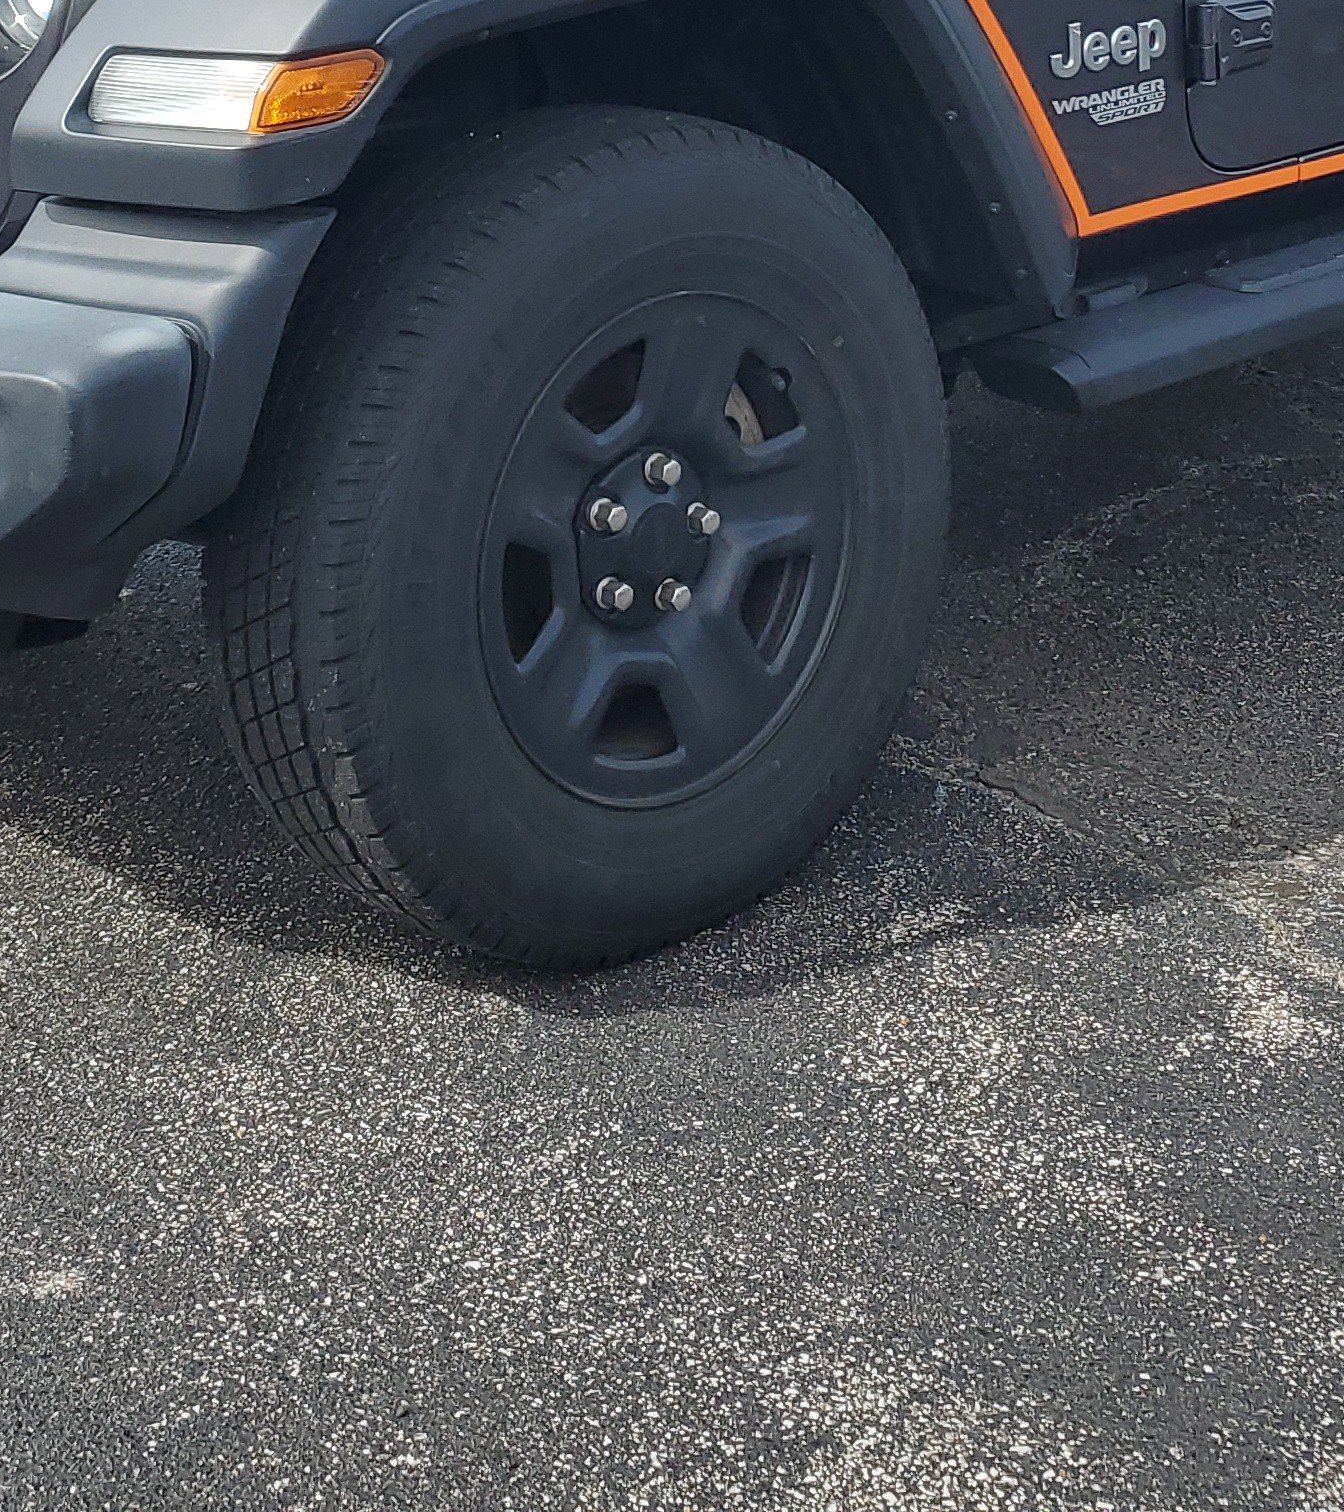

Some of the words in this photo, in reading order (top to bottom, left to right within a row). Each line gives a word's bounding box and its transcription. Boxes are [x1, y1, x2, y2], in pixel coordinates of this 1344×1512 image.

[1049, 18, 1167, 79] Jeep
[1051, 78, 1166, 115] WRANGLER
[1088, 90, 1167, 115] UNLIMITED
[1095, 101, 1165, 125] SPORT
